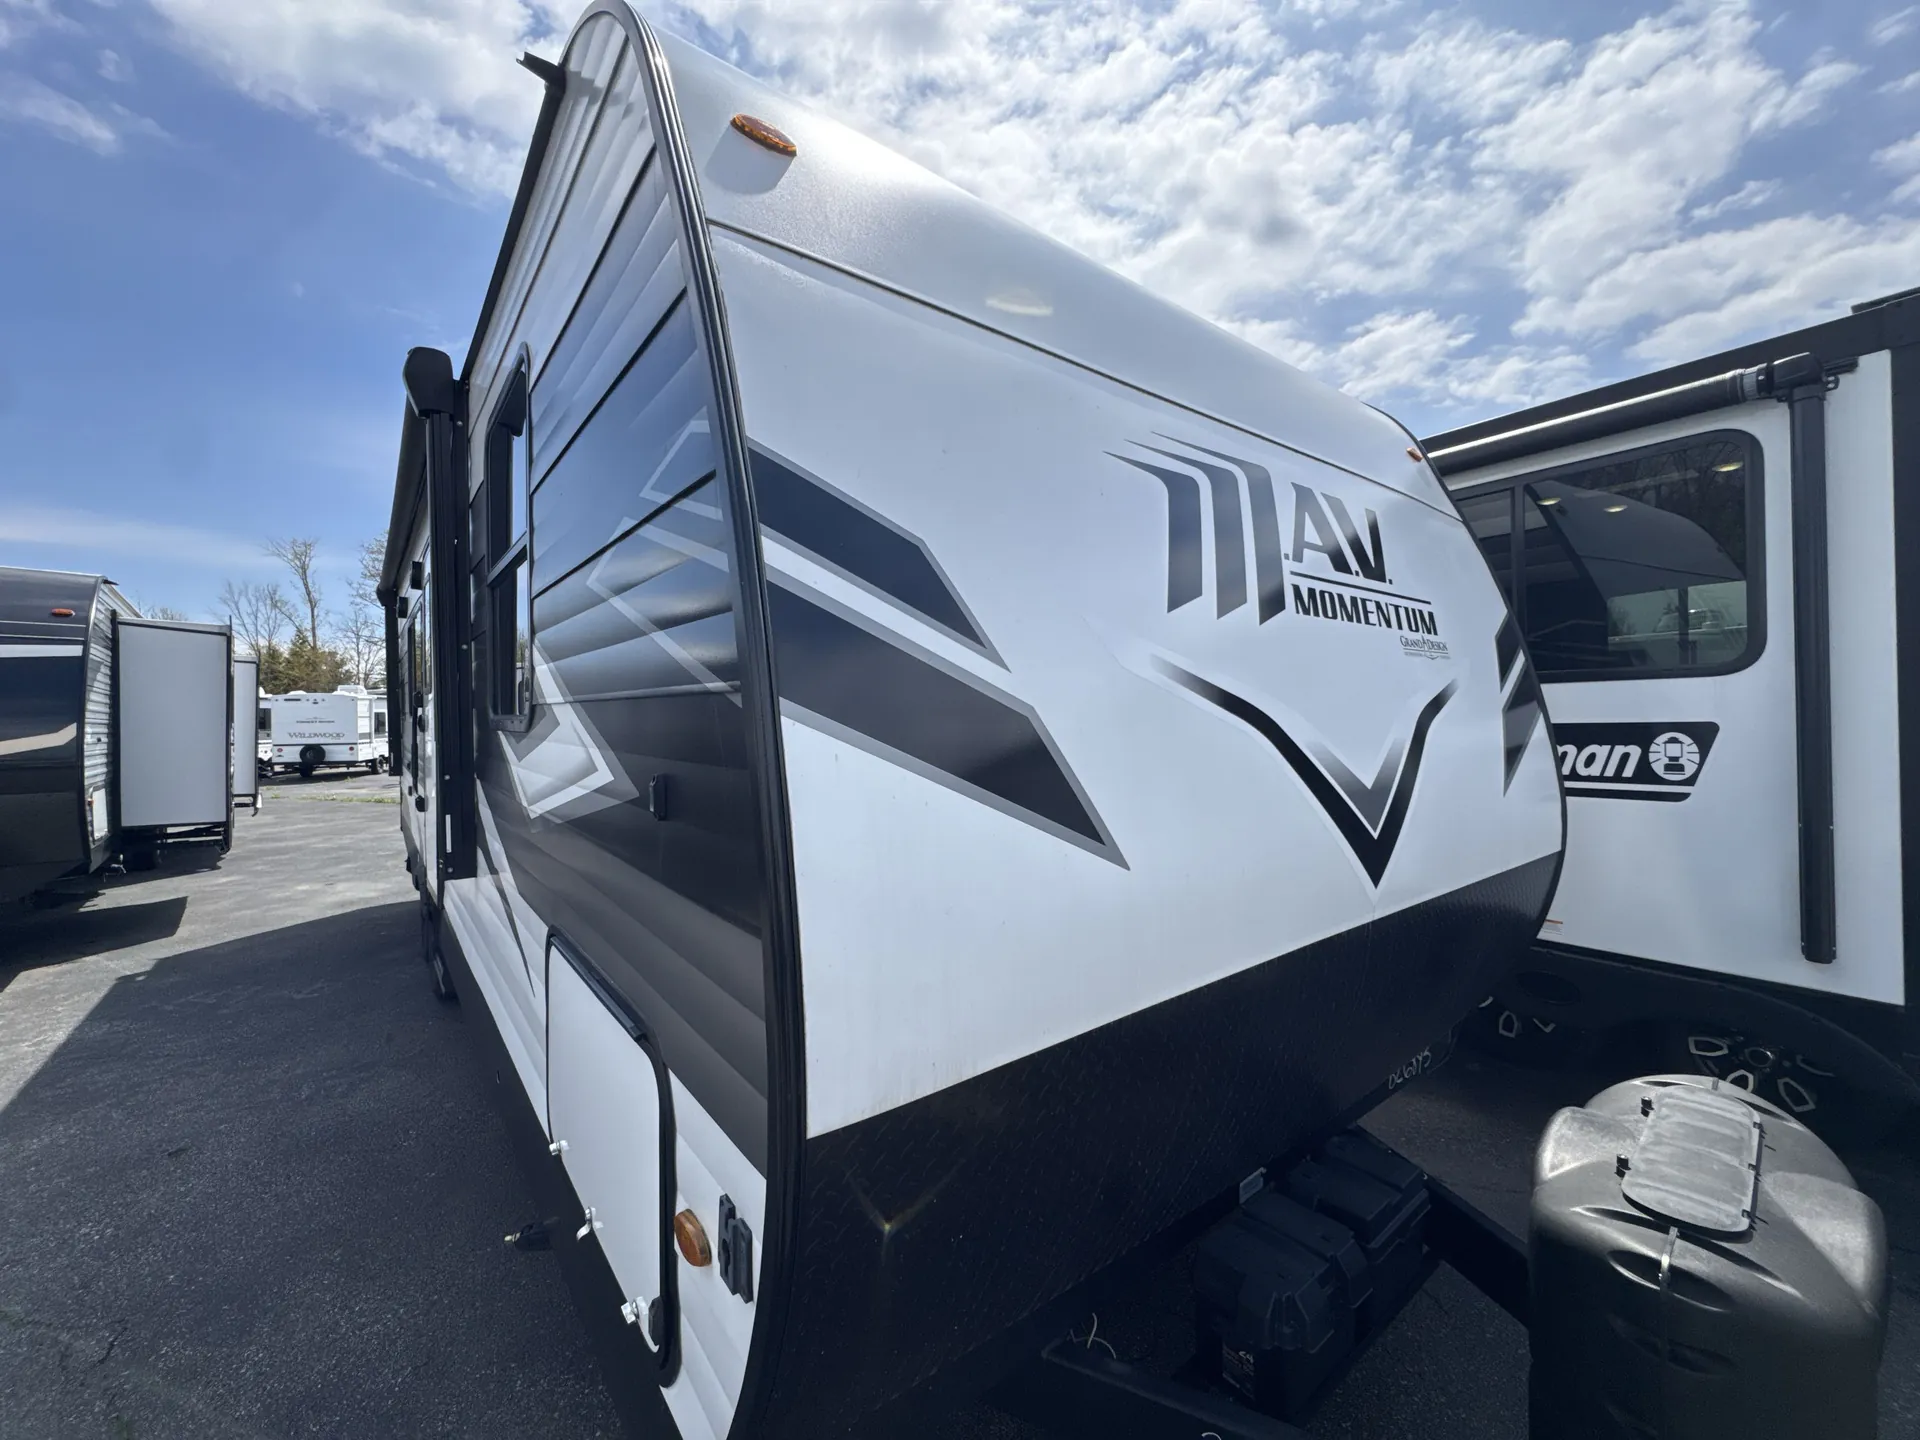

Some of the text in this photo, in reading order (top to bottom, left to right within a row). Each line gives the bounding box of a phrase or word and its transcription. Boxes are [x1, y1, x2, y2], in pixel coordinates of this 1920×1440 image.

[1291, 583, 1439, 637] MOMENTUM
[1400, 635, 1449, 652] GRAND DESIGN
